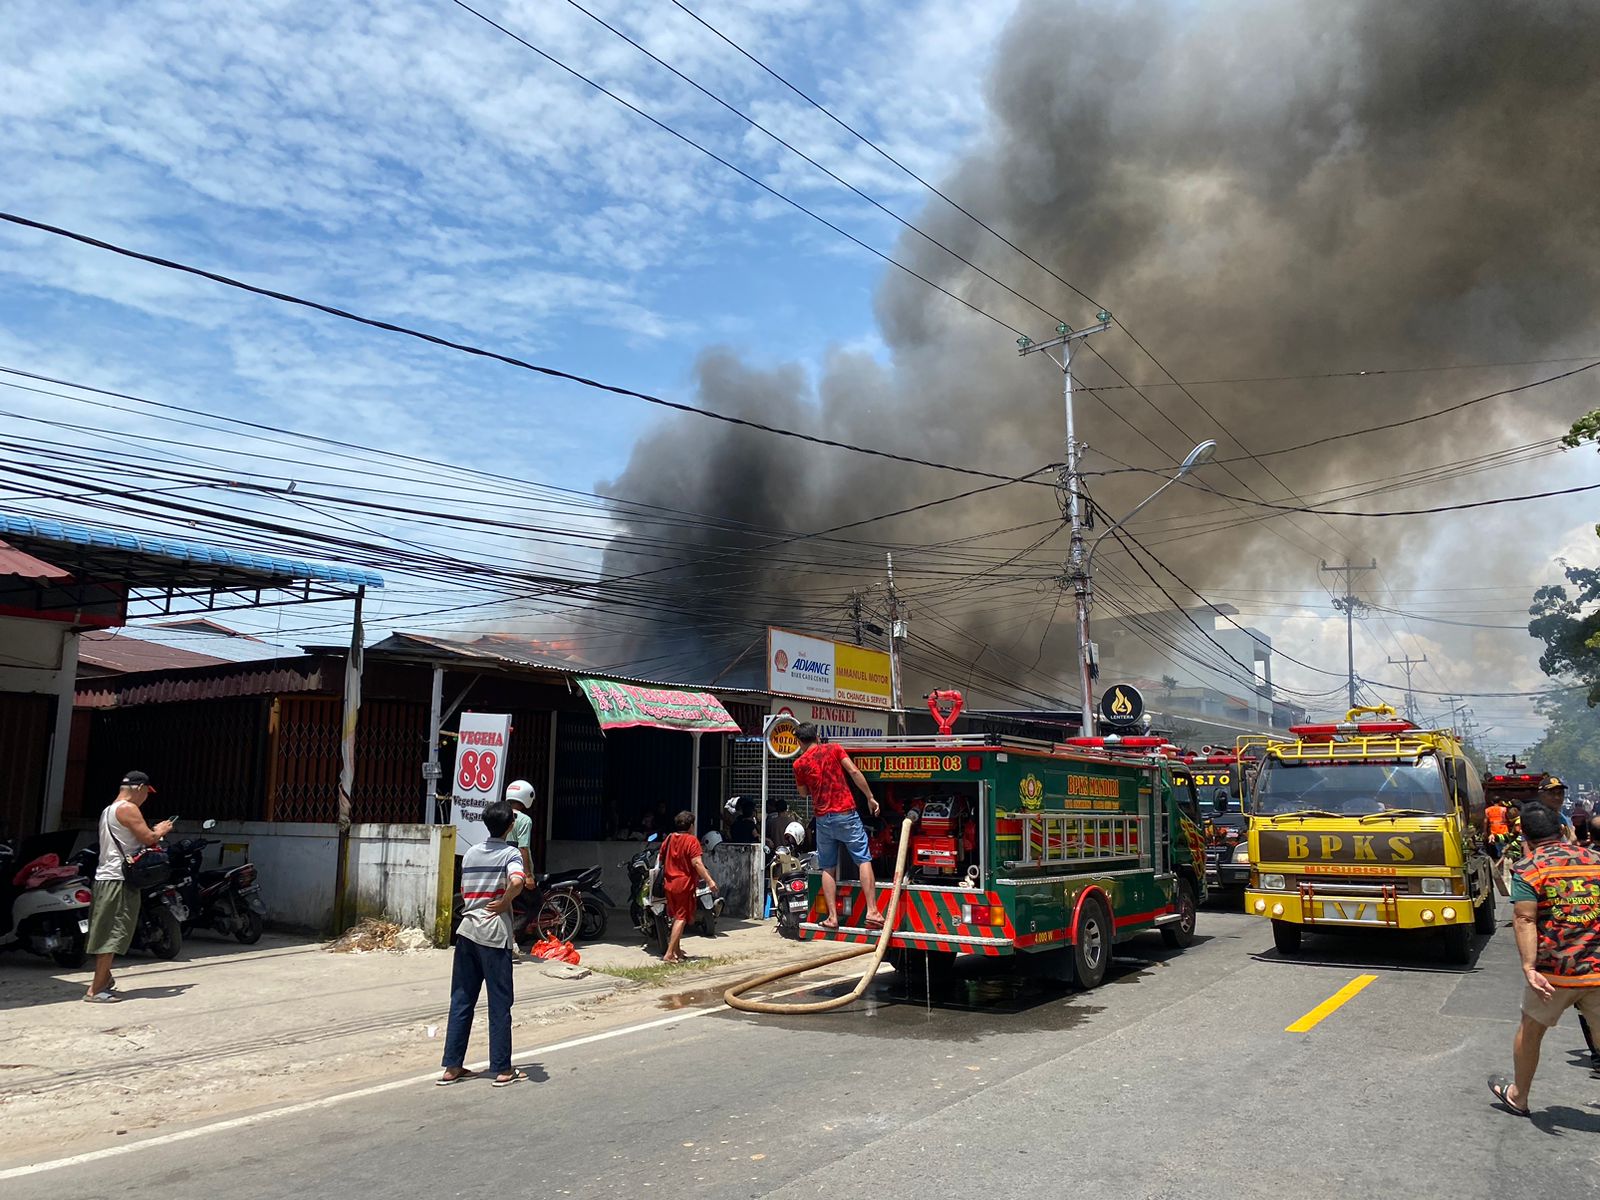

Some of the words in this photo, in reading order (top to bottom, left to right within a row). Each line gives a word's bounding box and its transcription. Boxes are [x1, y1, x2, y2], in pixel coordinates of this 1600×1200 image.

[792, 658, 831, 676] ADVANCE
[836, 666, 867, 681] IMMANUEL
[869, 673, 889, 685] MOTOR
[813, 675, 829, 684] CENTRE
[837, 690, 846, 699] OIL
[847, 692, 866, 703] CHANGE
[870, 695, 888, 706] SERVICE
[634, 702, 702, 720] Vegetarian
[811, 706, 857, 724] BENGKEL
[460, 731, 503, 746] VEGEHA
[774, 724, 796, 736] SERVIC
[773, 736, 798, 746] MOTOR
[458, 748, 497, 792] 88
[854, 756, 882, 771] UNIT
[884, 756, 940, 771] FIGHTER
[943, 755, 961, 771] 03
[1089, 776, 1119, 798] MANDIRI
[1287, 835, 1415, 862] BPKS
[1305, 866, 1397, 876] MITSUBISHI
[1545, 879, 1600, 898] BPKS
[1567, 896, 1599, 905] PEKON
